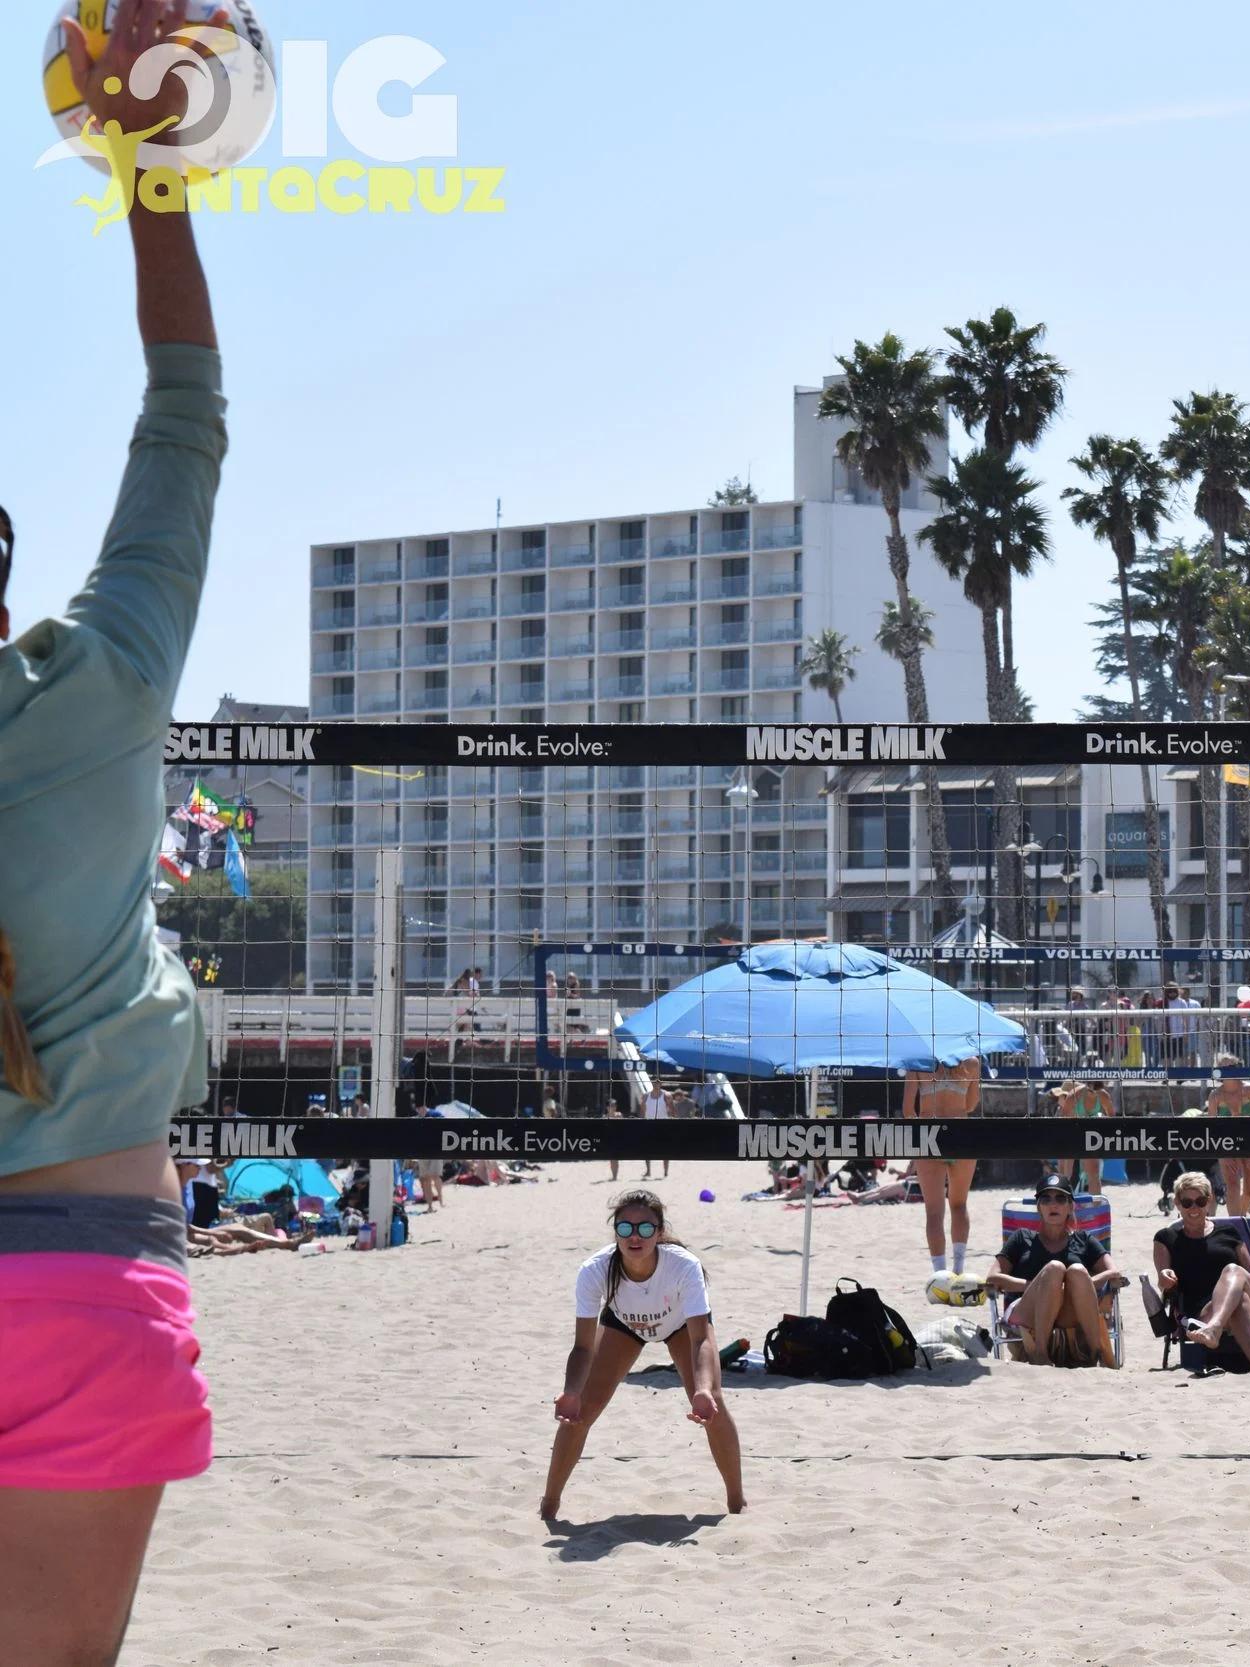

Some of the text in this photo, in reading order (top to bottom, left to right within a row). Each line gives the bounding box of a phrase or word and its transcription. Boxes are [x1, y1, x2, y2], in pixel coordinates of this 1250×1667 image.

[164, 726, 315, 760] SCLE MILK
[457, 733, 532, 756] Drink.
[746, 726, 946, 760] MUSCLE MILK
[1086, 731, 1162, 754] Drink.
[889, 948, 1161, 960] MAIN BEACH VOLLEYBALL
[1043, 1069, 1167, 1079] www.santacruzwharf.com
[168, 1122, 297, 1156] CLE MILK
[441, 1129, 519, 1151] Drink.
[738, 1123, 941, 1158] MUSCLE MILK
[1085, 1128, 1162, 1151] Drink.
[622, 1306, 672, 1322] ORIGINAL
